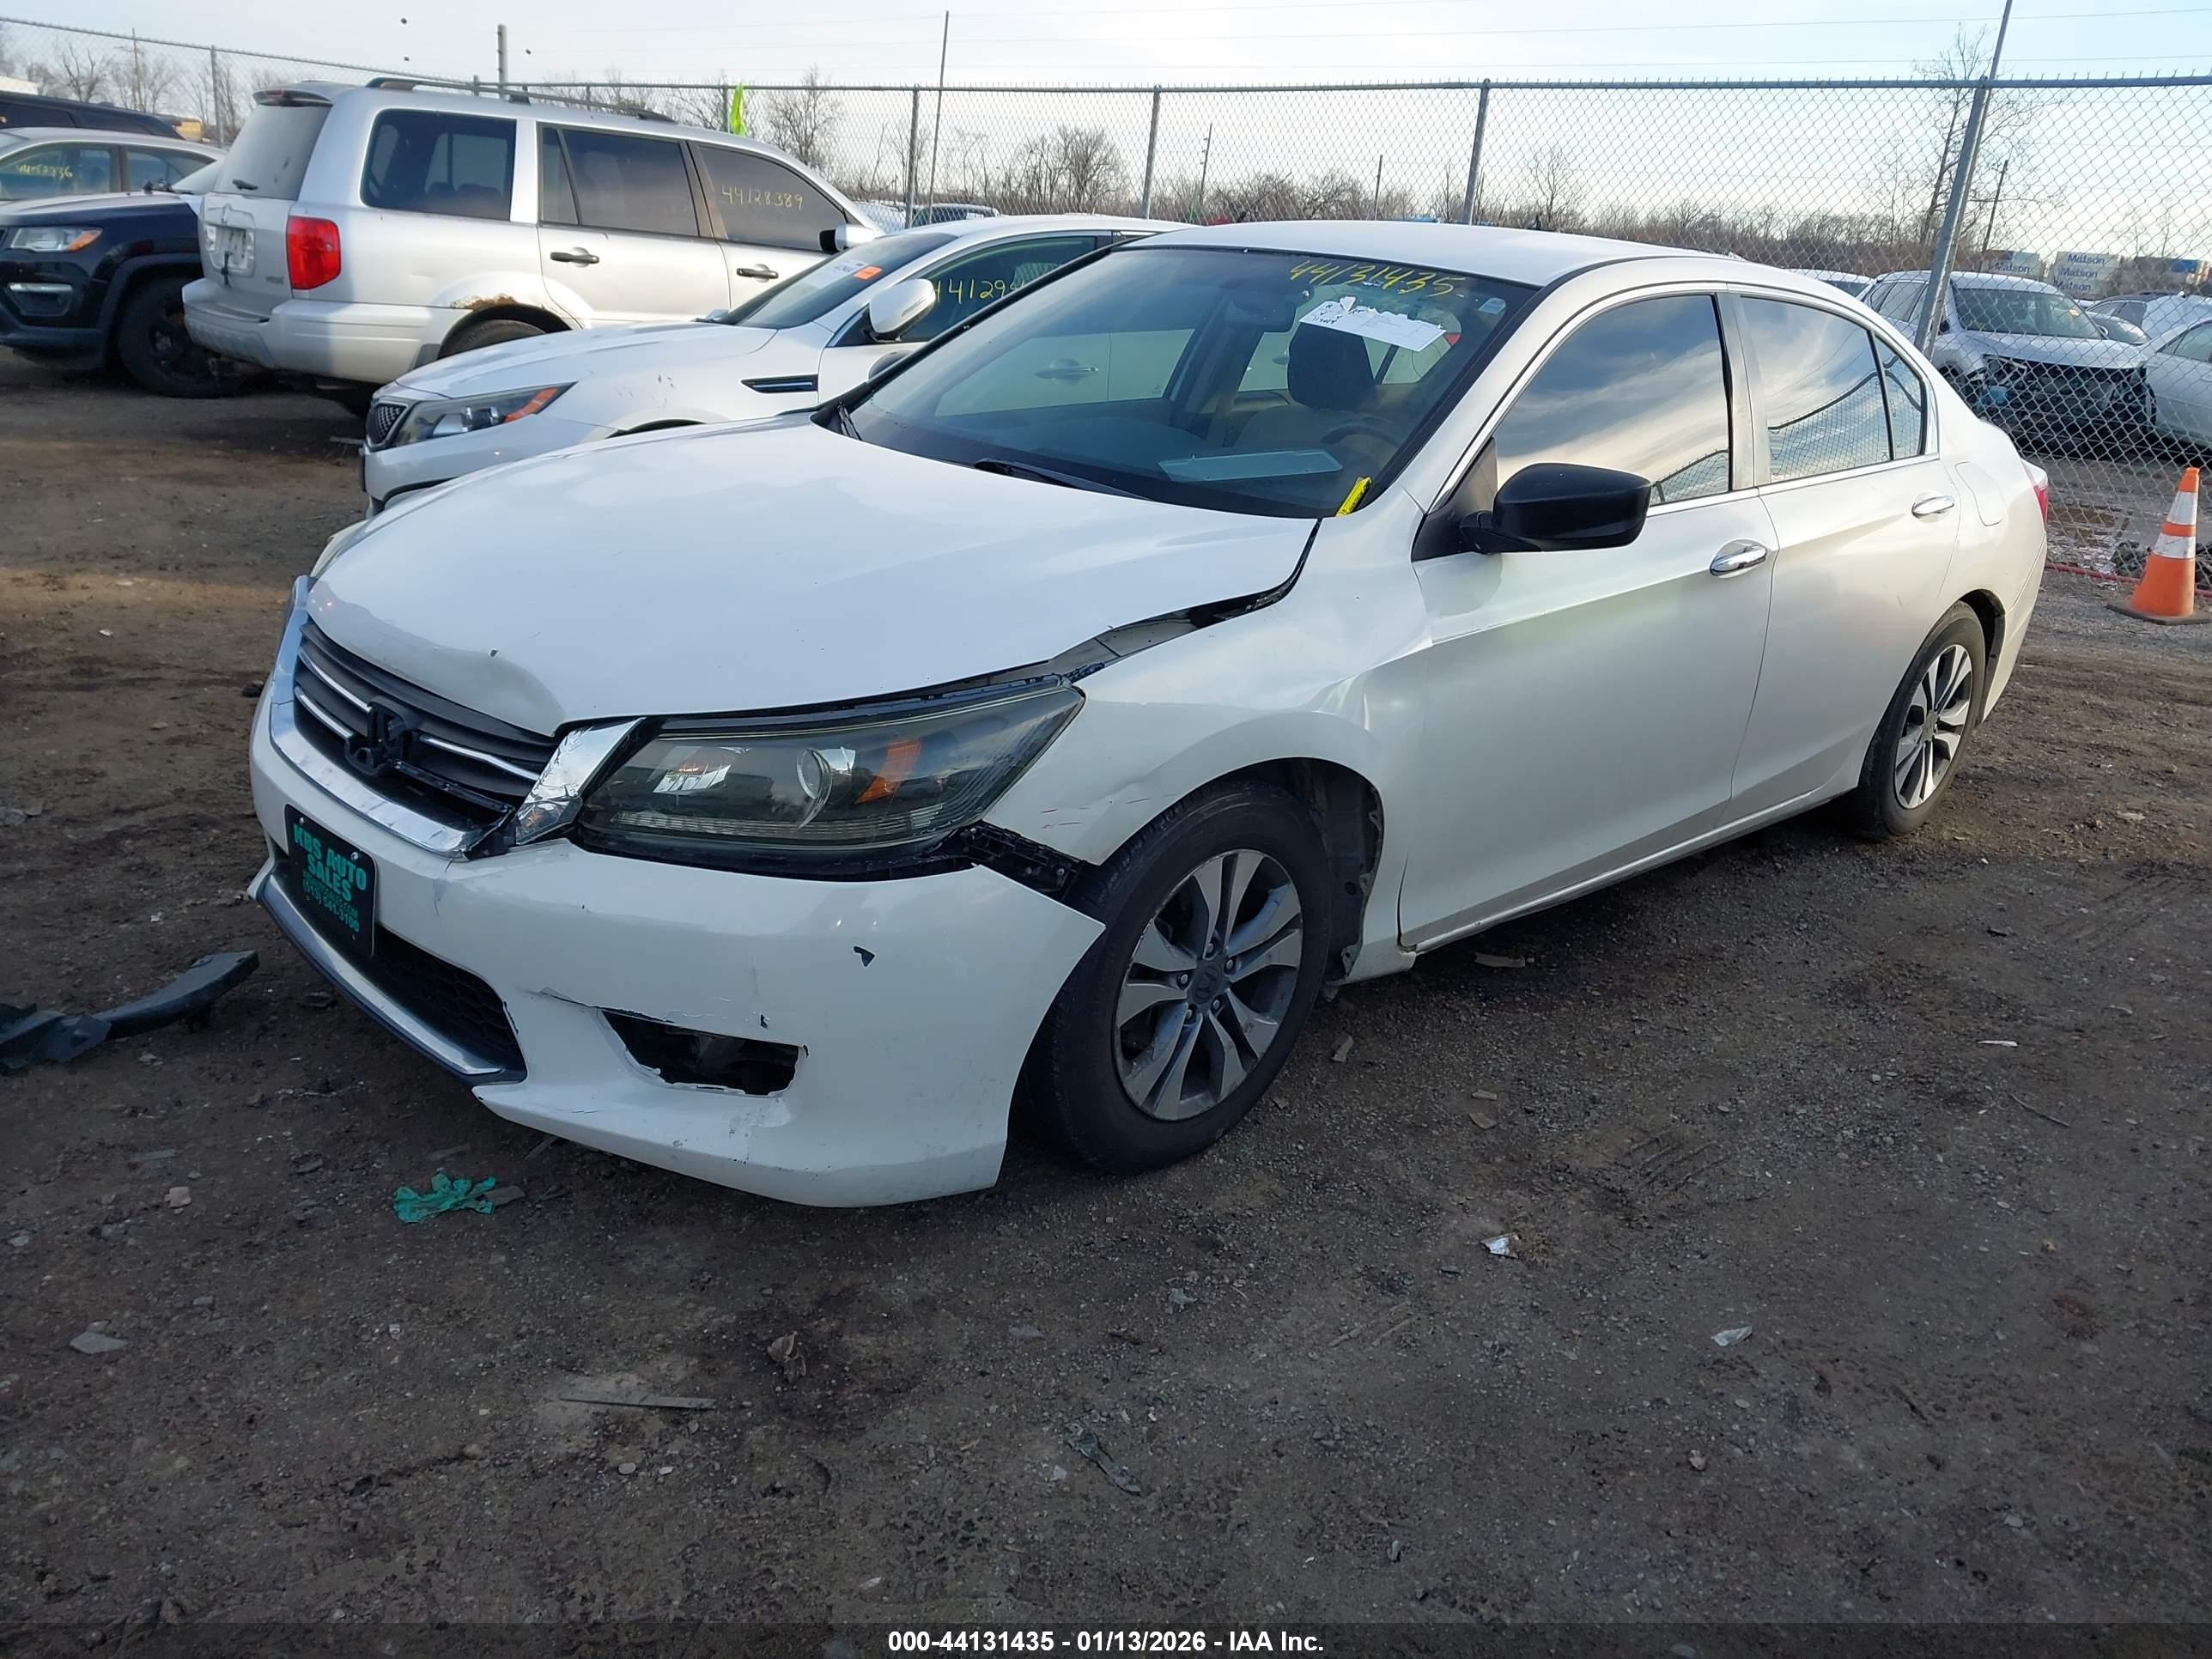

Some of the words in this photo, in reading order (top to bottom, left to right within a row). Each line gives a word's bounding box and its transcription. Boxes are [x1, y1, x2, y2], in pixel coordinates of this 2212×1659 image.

[721, 185, 803, 210] 44128389
[2061, 267, 2099, 279] Matson
[2068, 253, 2105, 265] Matson
[1290, 260, 1467, 297] 44131435
[307, 854, 351, 902] SALES
[326, 848, 367, 890] AUTO
